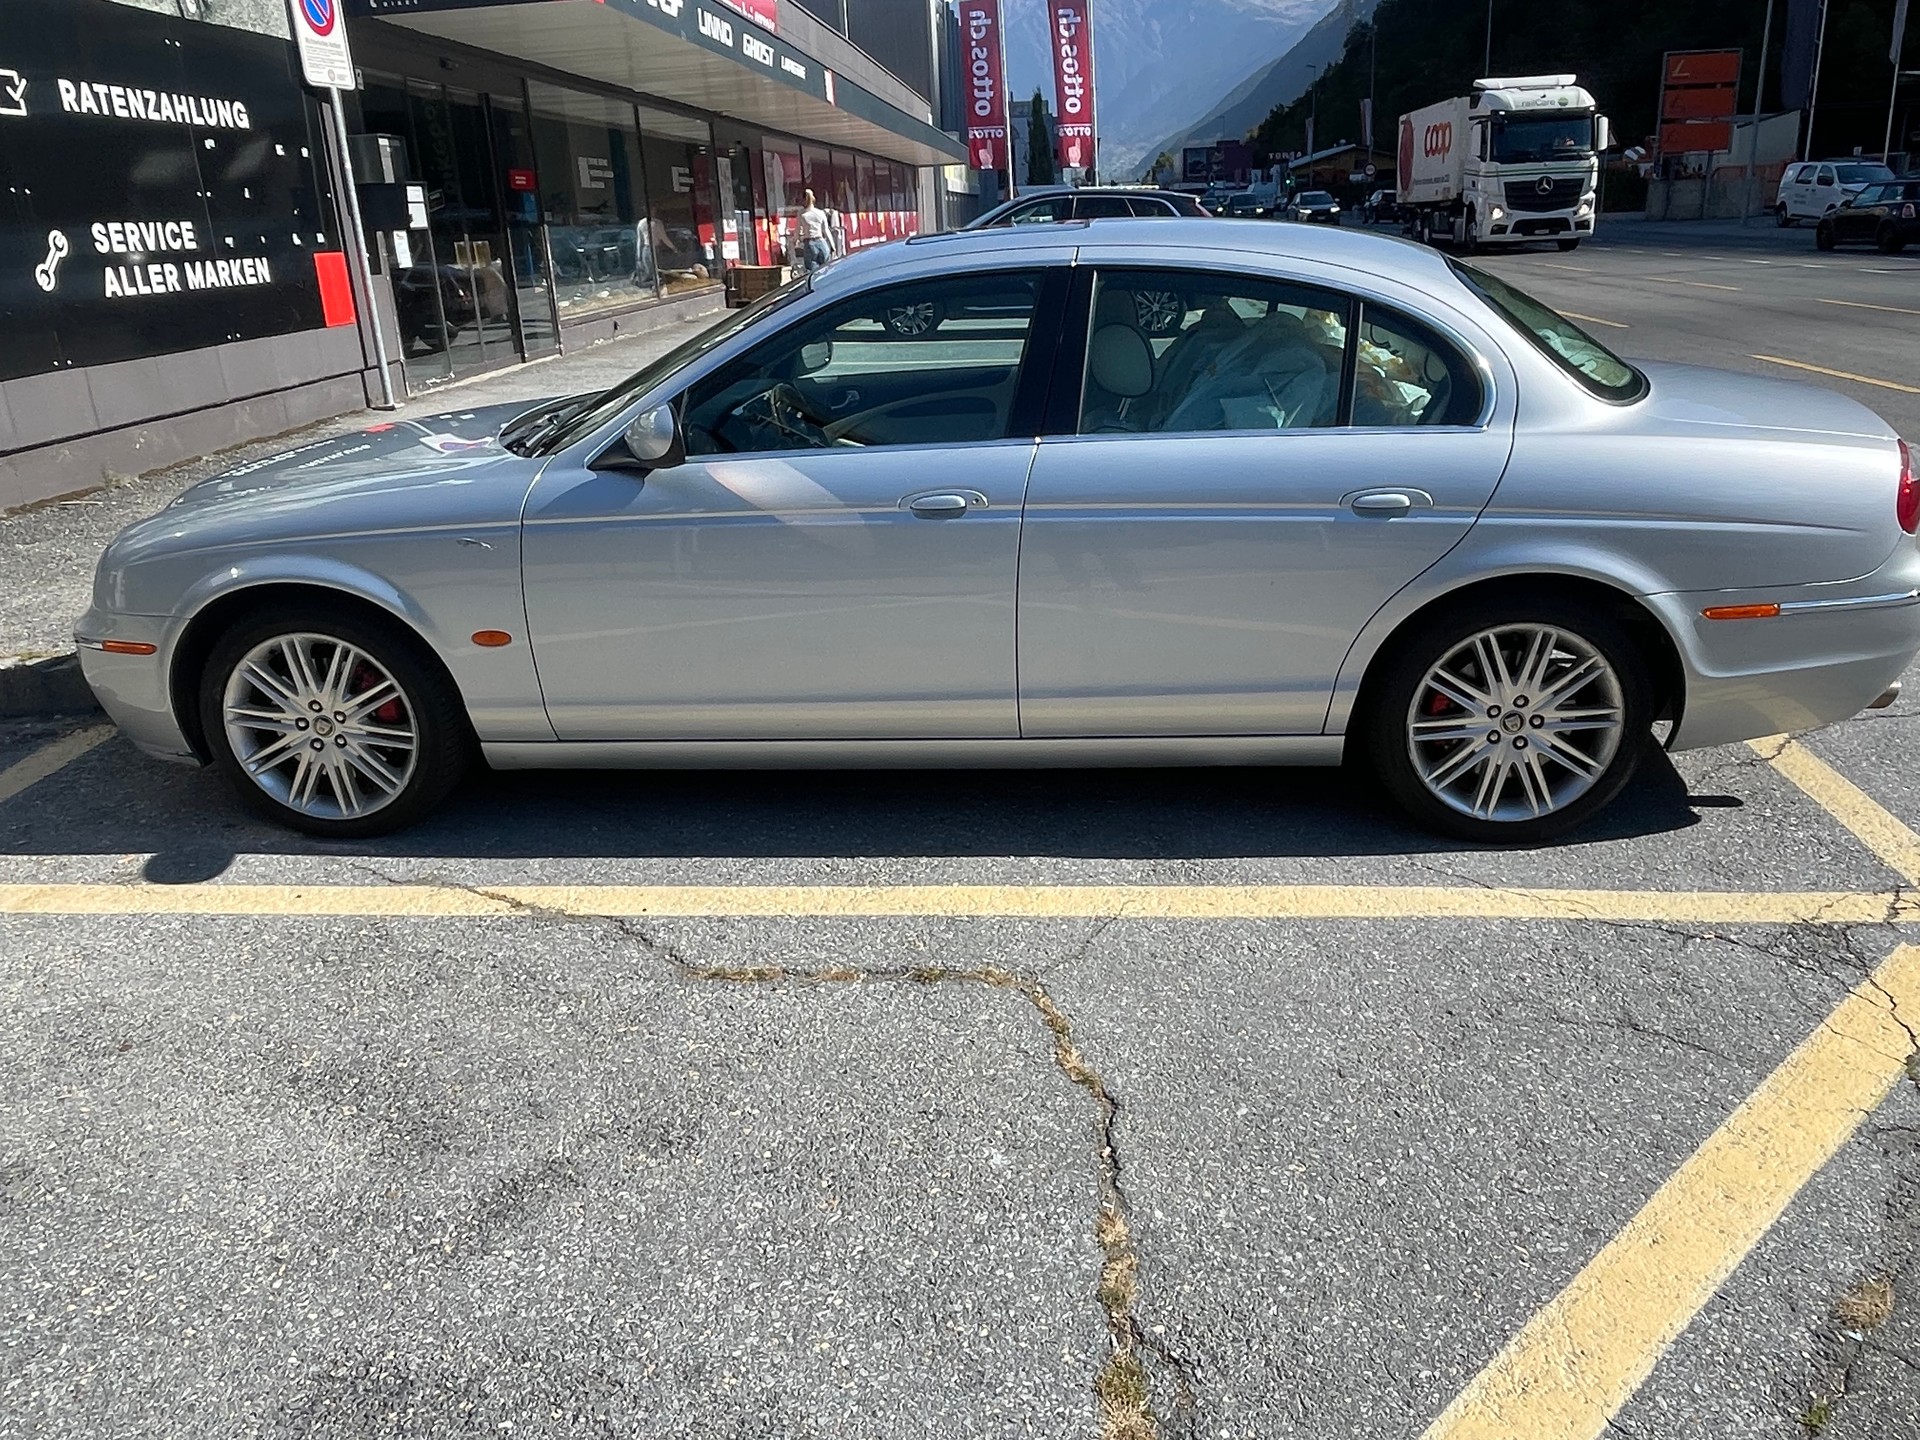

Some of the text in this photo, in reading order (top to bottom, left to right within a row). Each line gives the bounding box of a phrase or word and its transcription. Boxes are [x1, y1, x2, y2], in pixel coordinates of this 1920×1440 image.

[742, 33, 775, 67] GHOST
[57, 78, 251, 130] RATENZAHLUNG
[1424, 121, 1452, 164] coop
[91, 220, 198, 255] SERVICE
[104, 257, 272, 298] ALLER MARKEN
